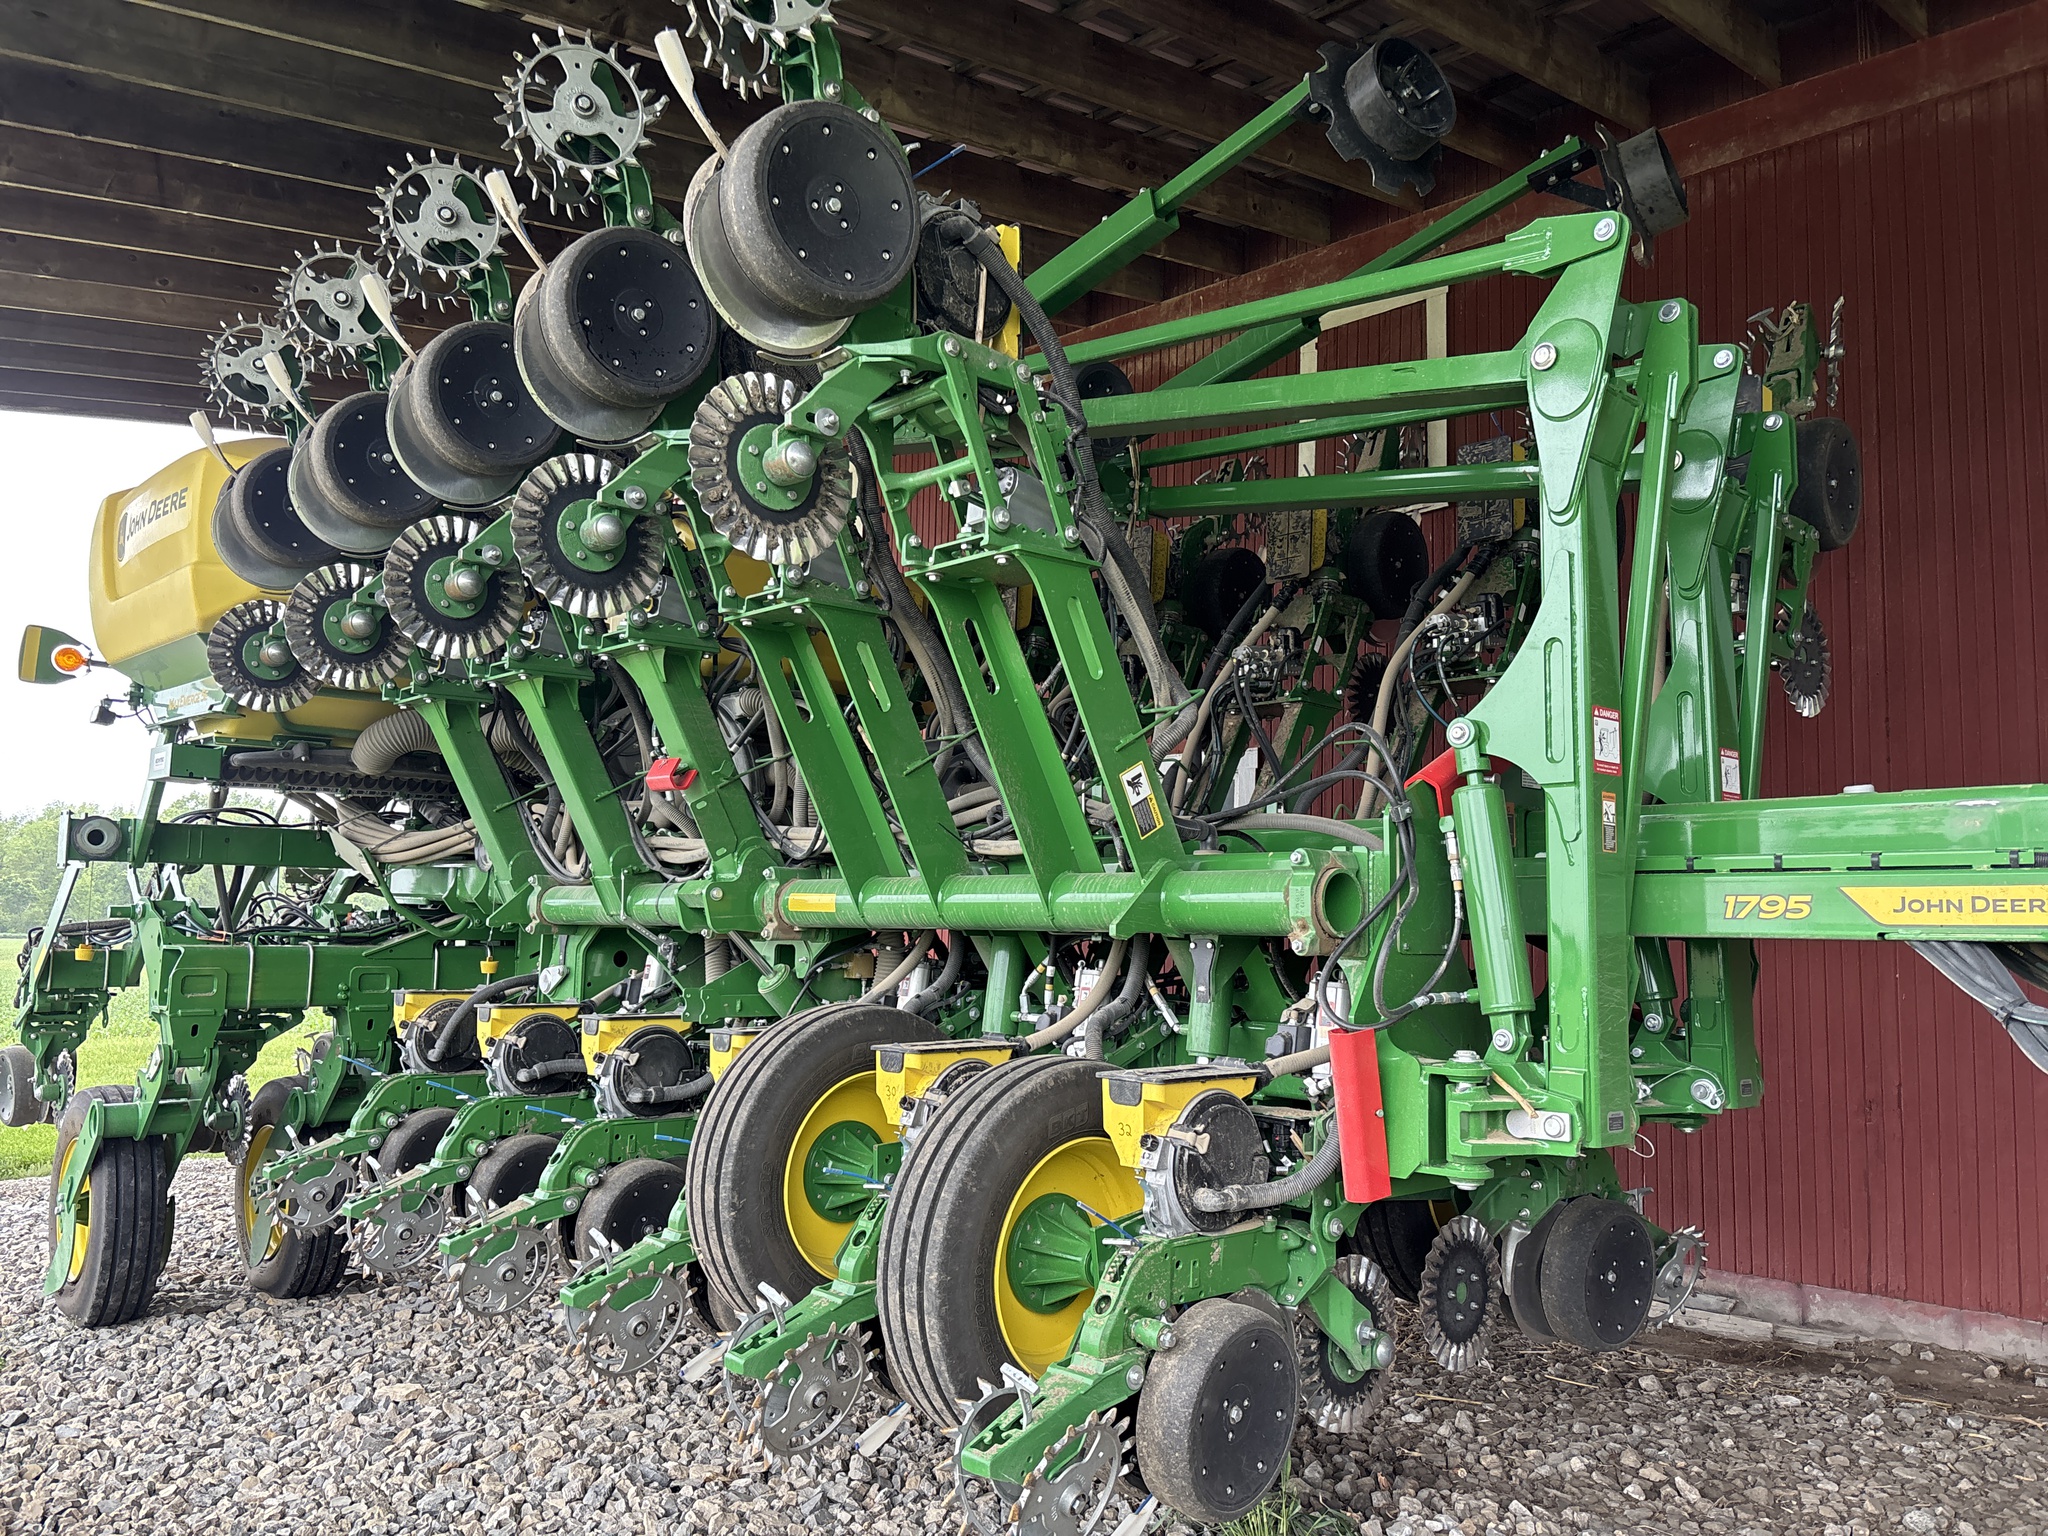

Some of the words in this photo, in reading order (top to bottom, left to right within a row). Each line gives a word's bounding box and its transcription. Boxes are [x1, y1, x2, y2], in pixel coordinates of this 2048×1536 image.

[126, 508, 148, 542] JOHN
[147, 486, 188, 525] DEERE
[1599, 708, 1619, 720] DANGER
[1151, 803, 1162, 826] CAUTION
[1723, 894, 1813, 920] 1795
[1893, 896, 1963, 914] JOHN
[885, 1084, 897, 1098] 30
[1047, 1100, 1090, 1141] BKT
[1117, 1121, 1133, 1137] 32
